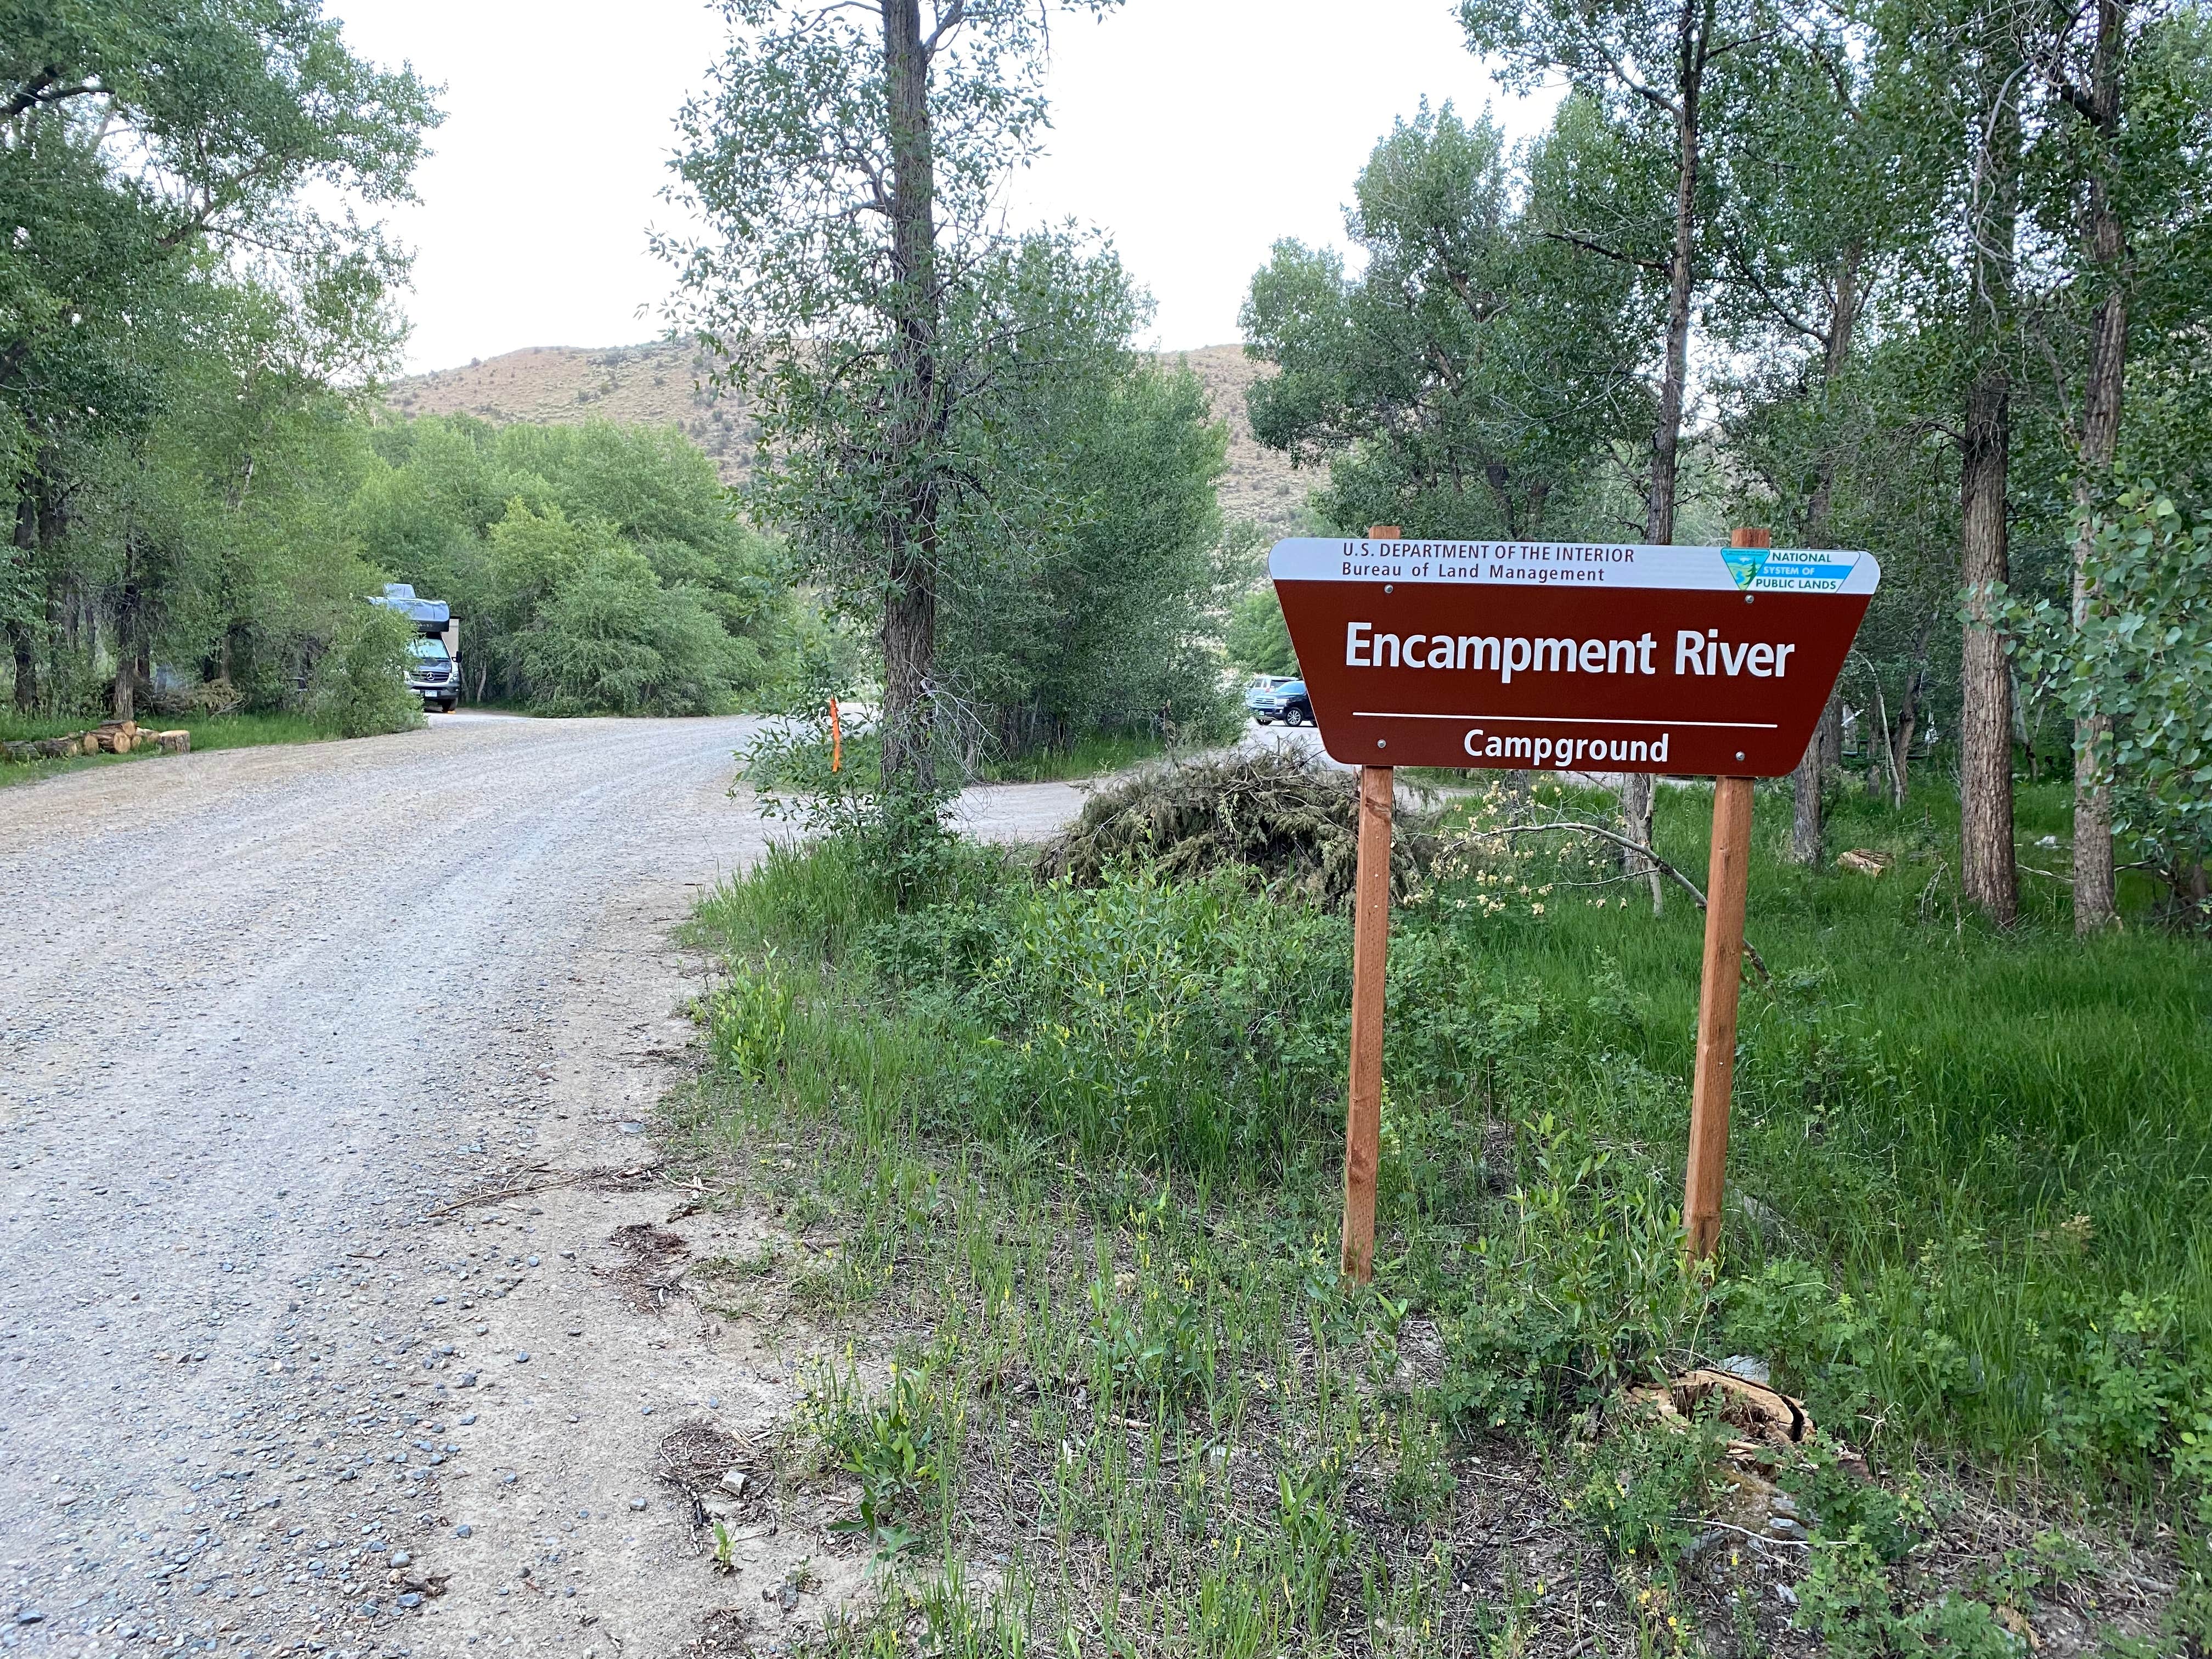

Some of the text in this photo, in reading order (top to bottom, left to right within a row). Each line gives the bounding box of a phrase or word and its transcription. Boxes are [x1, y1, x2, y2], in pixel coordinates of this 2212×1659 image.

[1343, 542, 1634, 563] U.S. DEPARTMENT OF THE INTERIOR
[1772, 552, 1831, 562] NATIONAL
[1342, 562, 1605, 584] Bureau of Land Management
[1763, 566, 1815, 575] SYSTEM OF
[1756, 578, 1836, 590] PUBLIC LANDS
[1346, 622, 1795, 684] Encampment River
[1464, 729, 1669, 767] Campground
